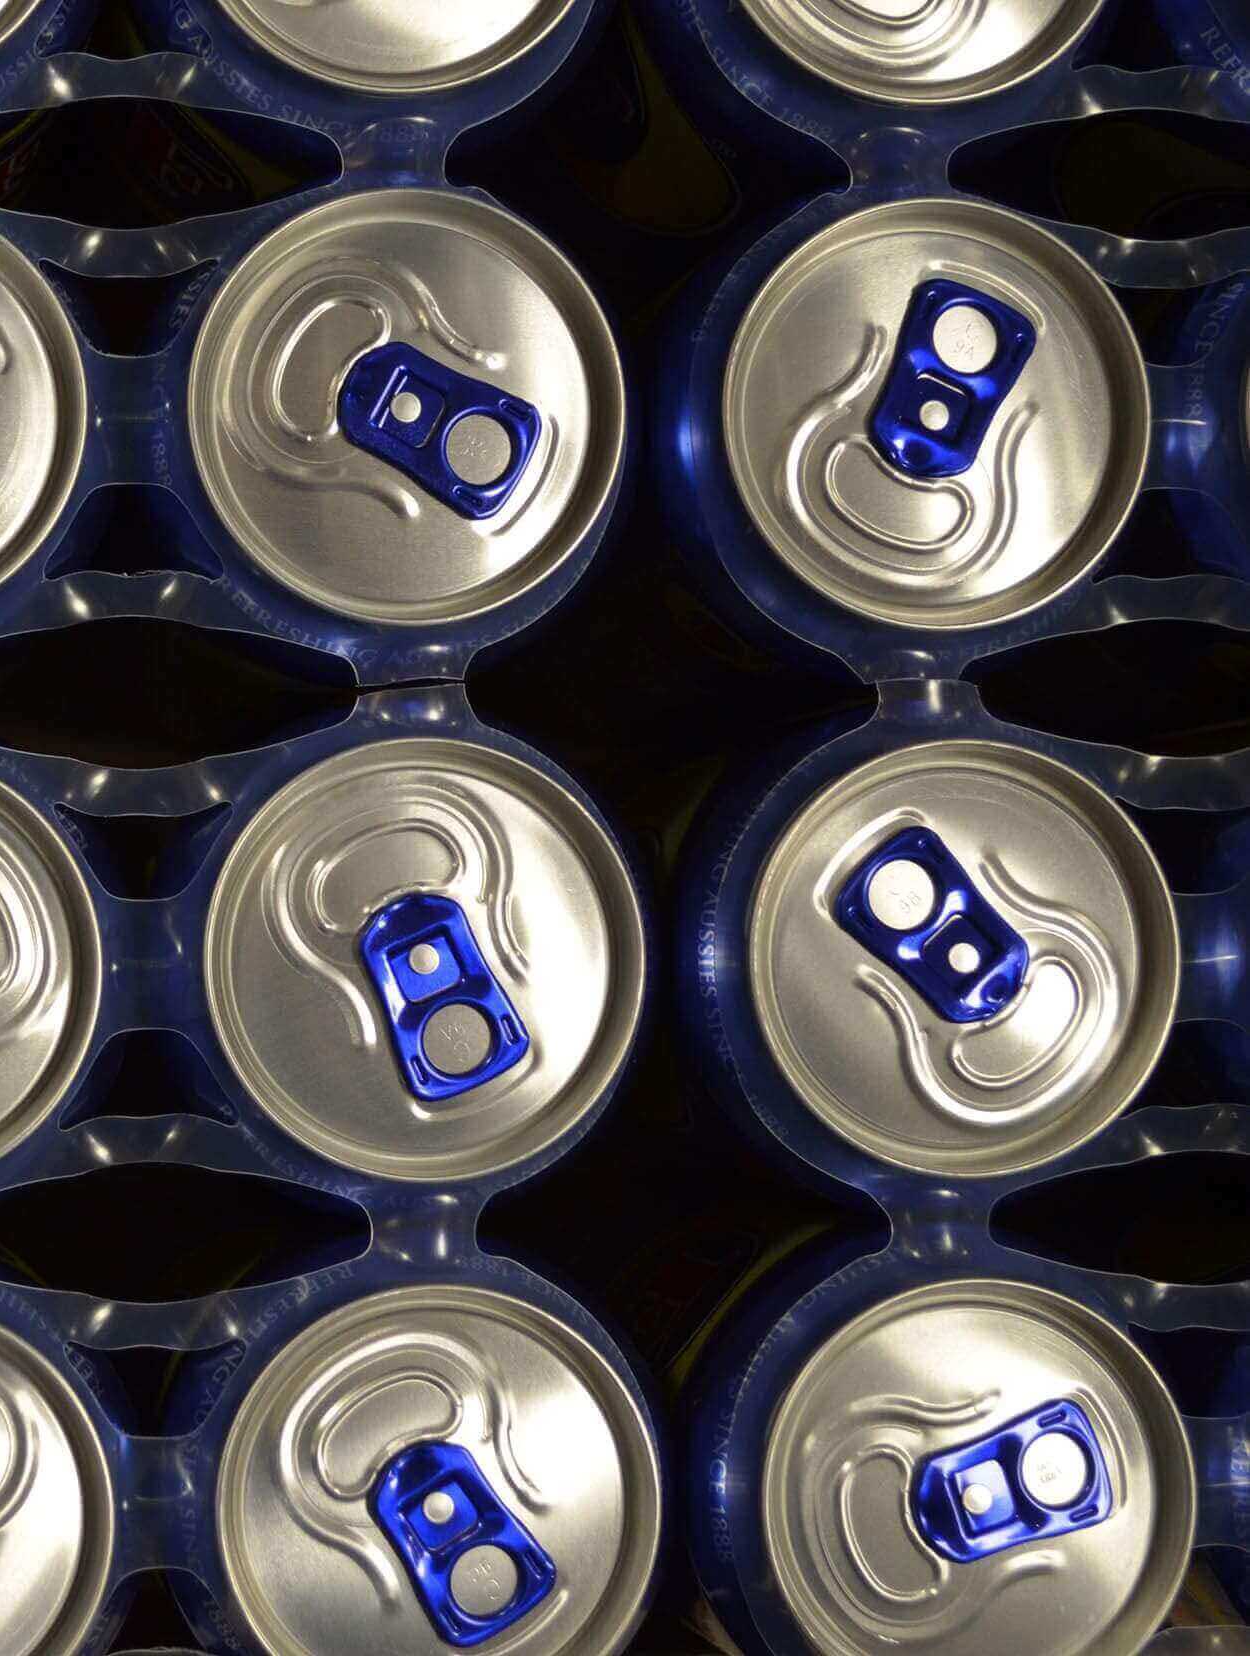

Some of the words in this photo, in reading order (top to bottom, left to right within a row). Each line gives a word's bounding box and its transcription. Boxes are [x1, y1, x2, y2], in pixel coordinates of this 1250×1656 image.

[184, 27, 276, 114] AUSSIES
[706, 45, 774, 109] SINCE
[148, 427, 174, 487] 1888
[212, 567, 376, 668] REFRESHING
[695, 887, 722, 1000] AUSSIES
[210, 1258, 357, 1386] REFRESHING
[706, 1403, 742, 1494] SINCE
[707, 1501, 735, 1569] 1888
